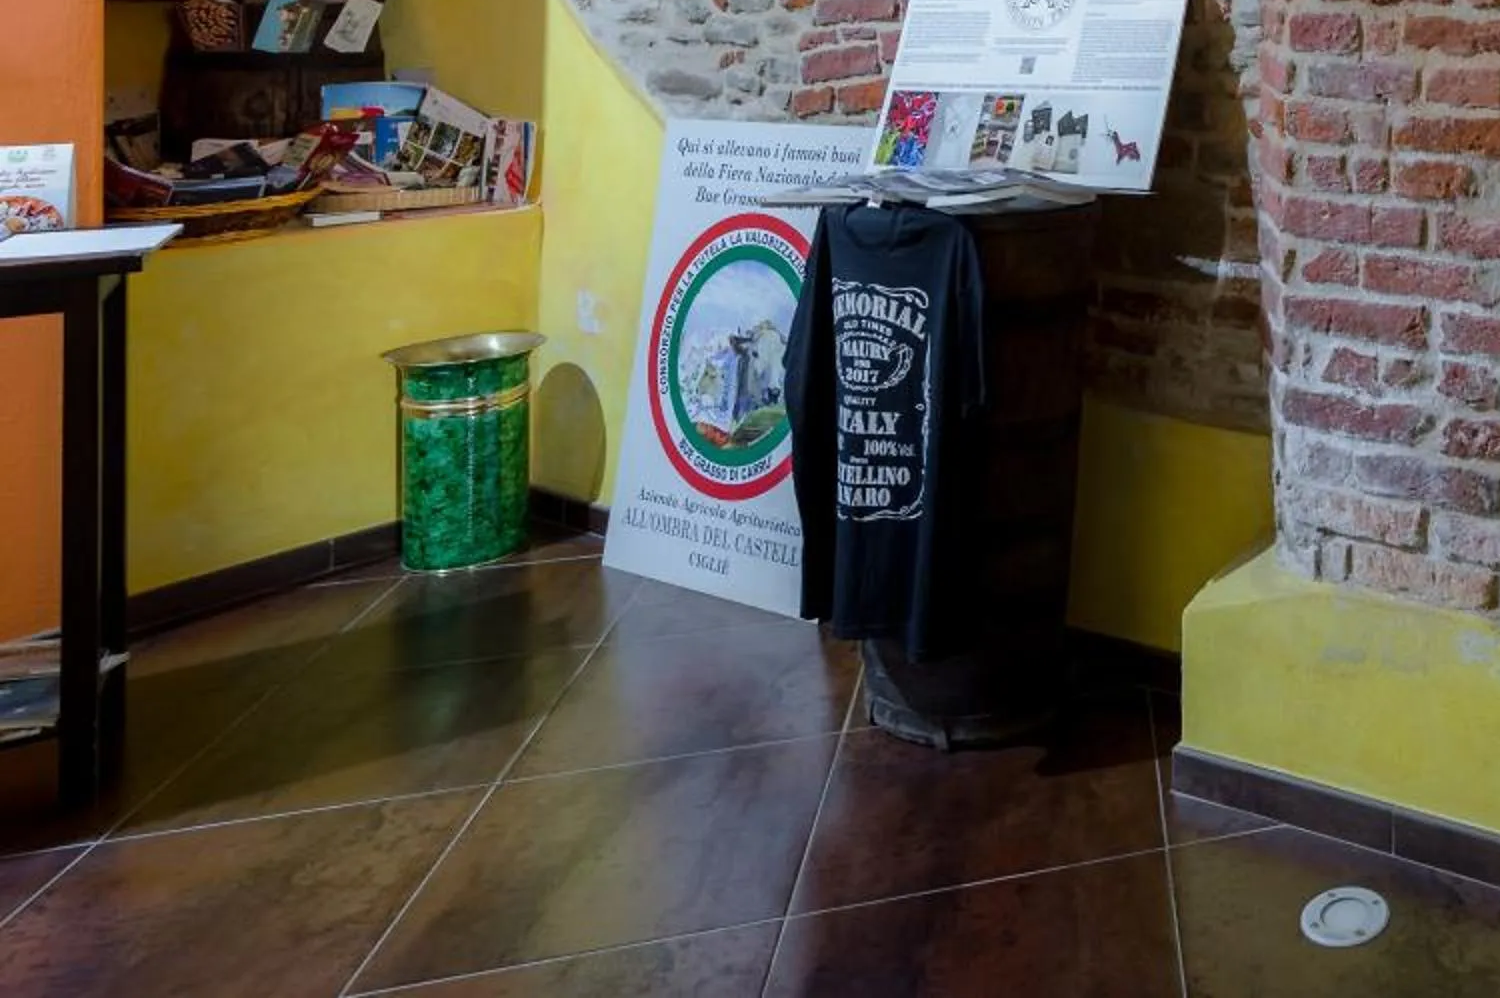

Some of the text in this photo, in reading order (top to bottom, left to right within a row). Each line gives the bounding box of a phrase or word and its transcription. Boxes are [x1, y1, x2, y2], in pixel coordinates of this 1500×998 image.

[677, 137, 699, 157] Qui
[718, 163, 751, 181] Fiera
[659, 231, 807, 395] CONSORZIO PER LA TUTELA LA VALORIZZAZIO
[845, 367, 880, 384] 2017
[863, 439, 897, 457] 100%
[693, 455, 728, 482] GRASSO
[729, 467, 740, 482] DI
[638, 486, 680, 509] Azienda
[682, 496, 727, 520] Agricola
[702, 524, 732, 551] DEL
[733, 532, 801, 568] CASTELL
